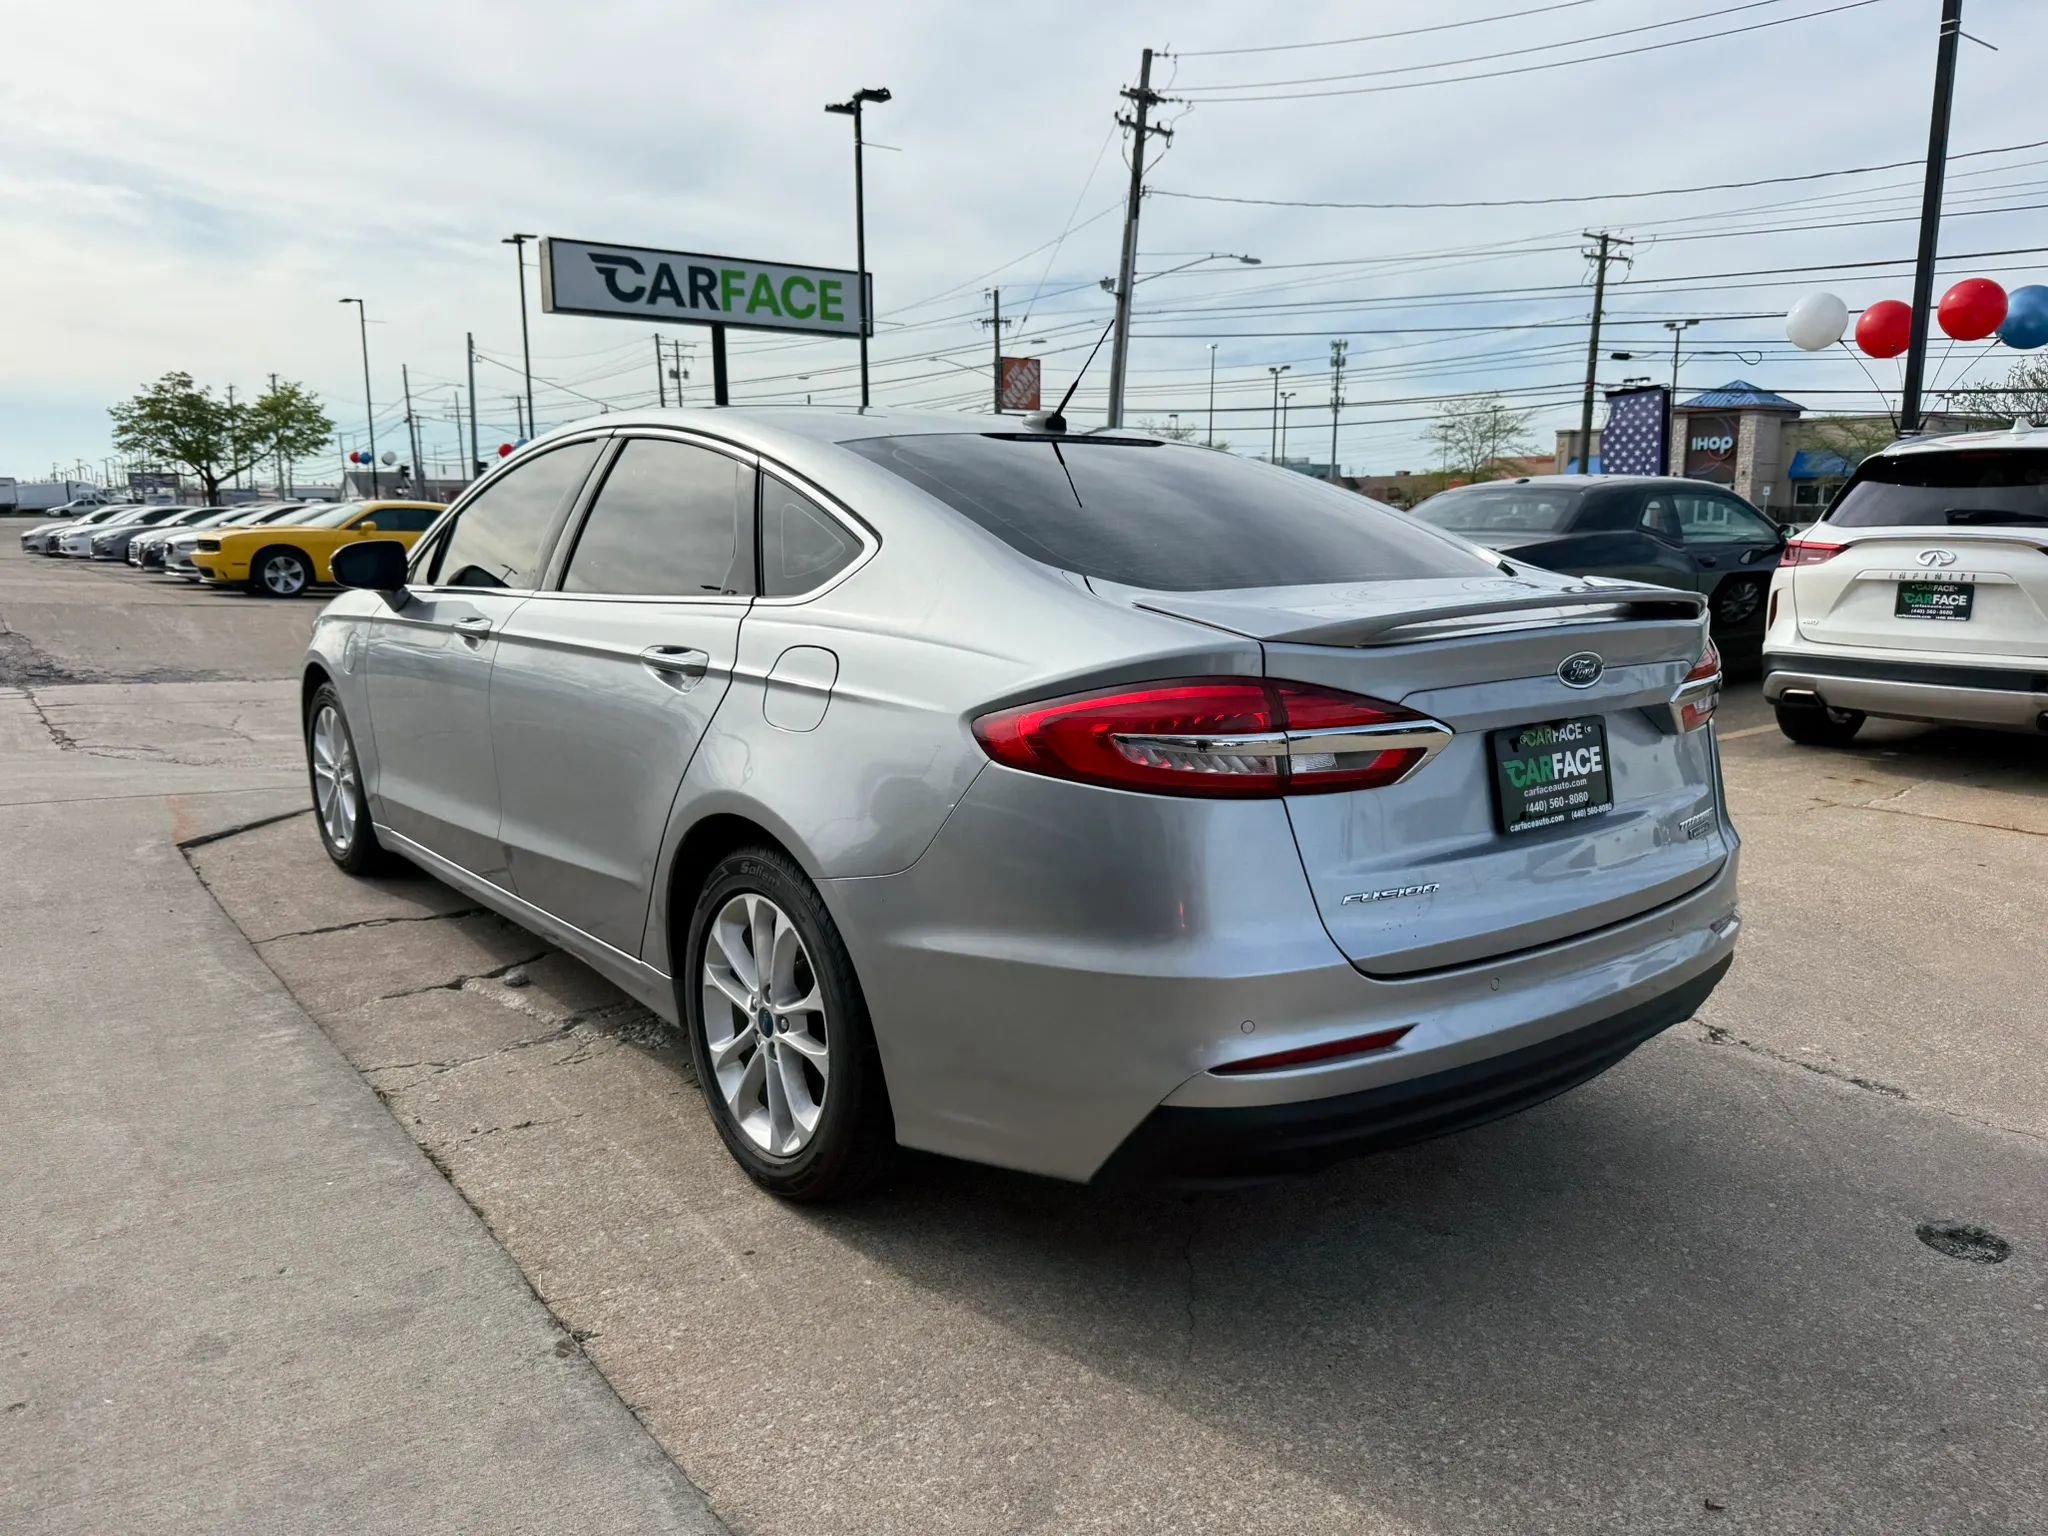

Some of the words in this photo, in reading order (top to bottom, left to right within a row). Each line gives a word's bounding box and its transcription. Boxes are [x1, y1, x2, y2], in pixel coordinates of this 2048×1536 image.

[588, 253, 845, 322] CARFACE
[1002, 361, 1040, 408] HOME
[1692, 436, 1733, 454] IHOP
[1889, 571, 1976, 582] INFINITI
[1902, 592, 1967, 606] CARFACE
[1570, 659, 1596, 680] Ford
[1502, 745, 1603, 788] CARFACE
[1523, 778, 1587, 797] carfaceauto.com
[1525, 799, 1548, 813] (440)
[1510, 813, 1565, 833] carfaceauto.com
